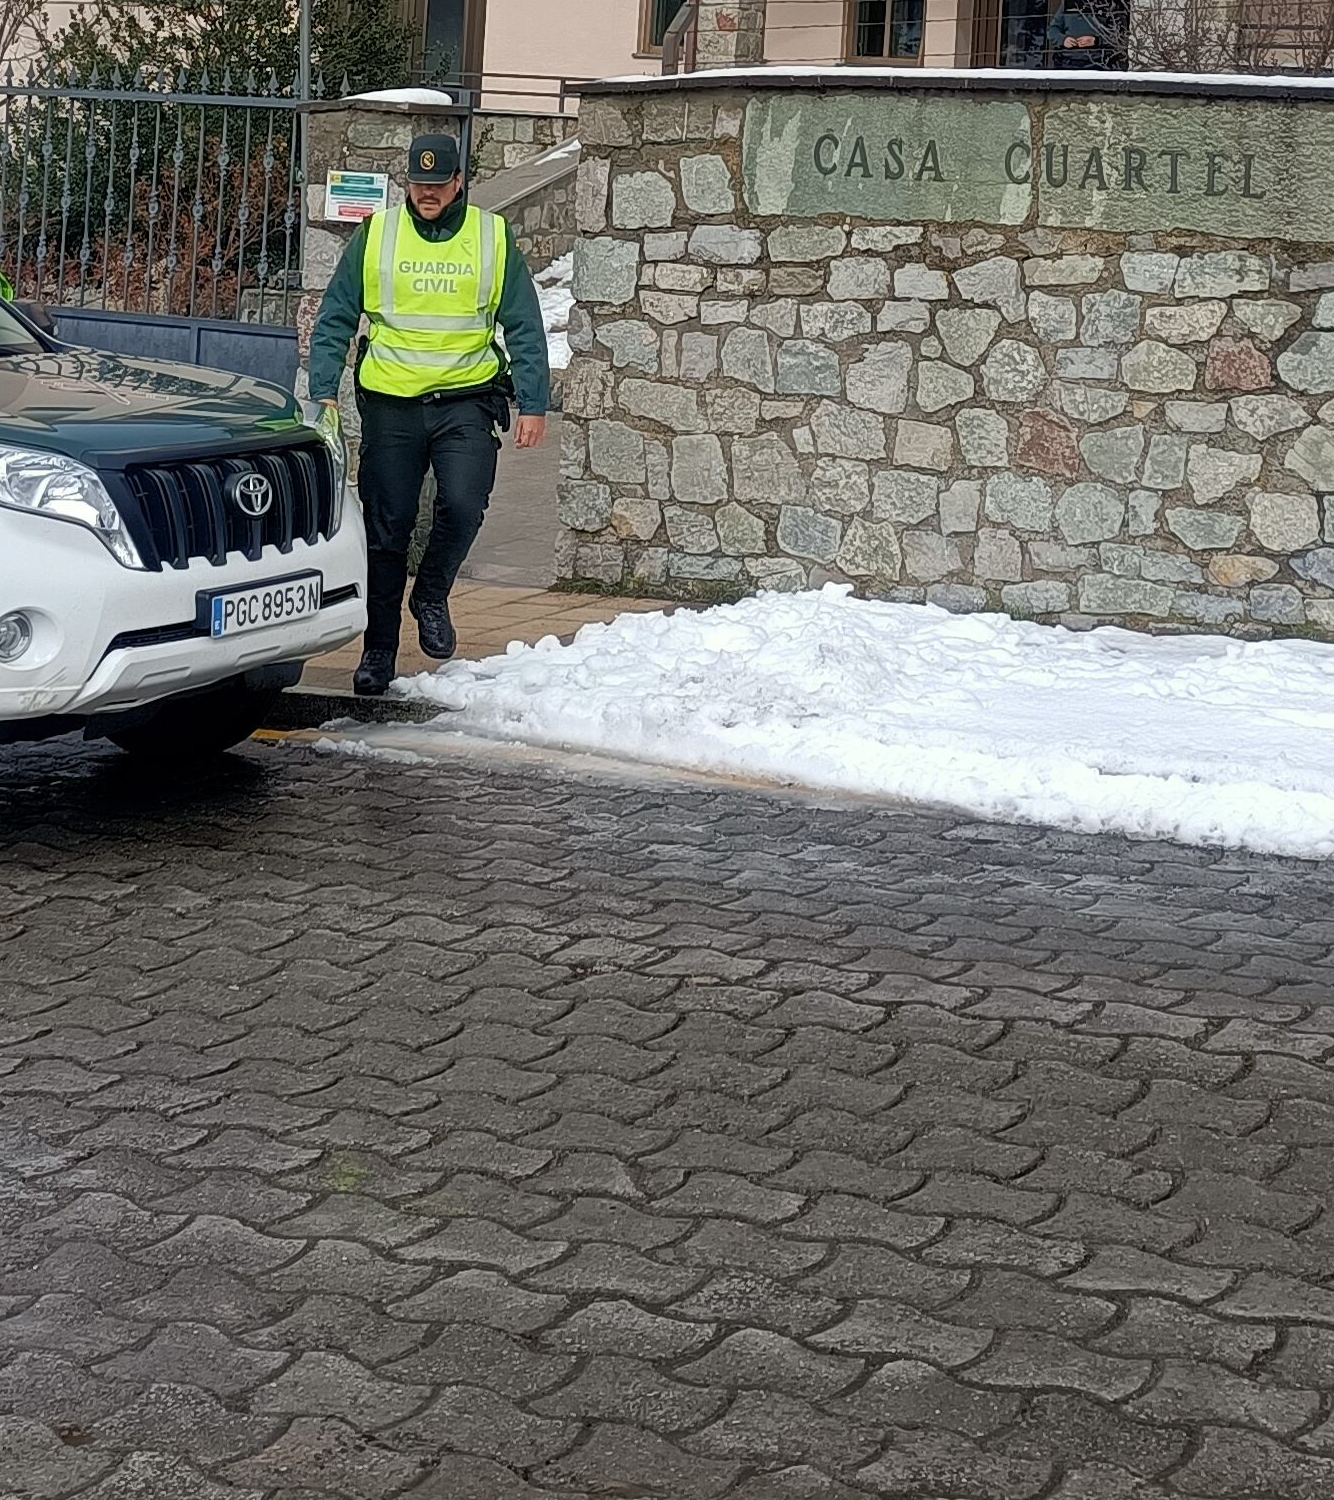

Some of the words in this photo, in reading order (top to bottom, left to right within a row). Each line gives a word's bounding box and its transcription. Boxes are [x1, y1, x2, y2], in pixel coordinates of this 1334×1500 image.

[813, 133, 945, 182] CASA
[1004, 142, 1267, 199] CUARTEL
[398, 260, 475, 277] GUARDIA
[412, 278, 458, 294] CIVIL
